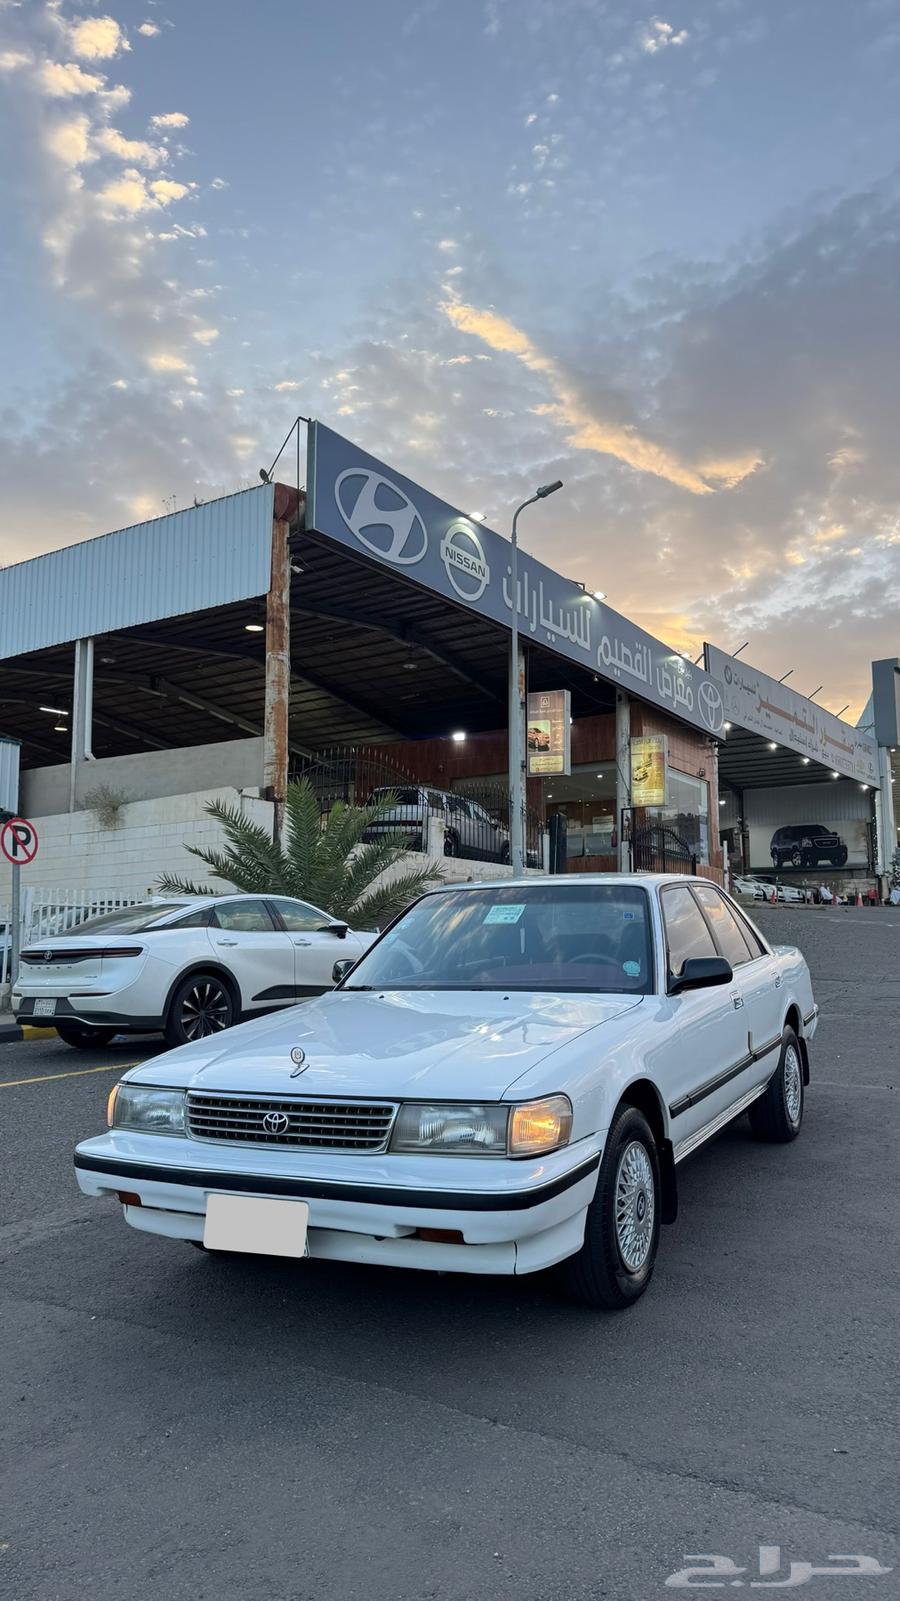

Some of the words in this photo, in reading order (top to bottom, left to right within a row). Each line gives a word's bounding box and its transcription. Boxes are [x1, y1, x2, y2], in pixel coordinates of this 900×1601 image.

[445, 546, 486, 578] NISSAN
[502, 565, 591, 651] للسيارات
[598, 635, 653, 685] القصيم
[656, 661, 694, 712] معرض
[12, 825, 32, 857] P
